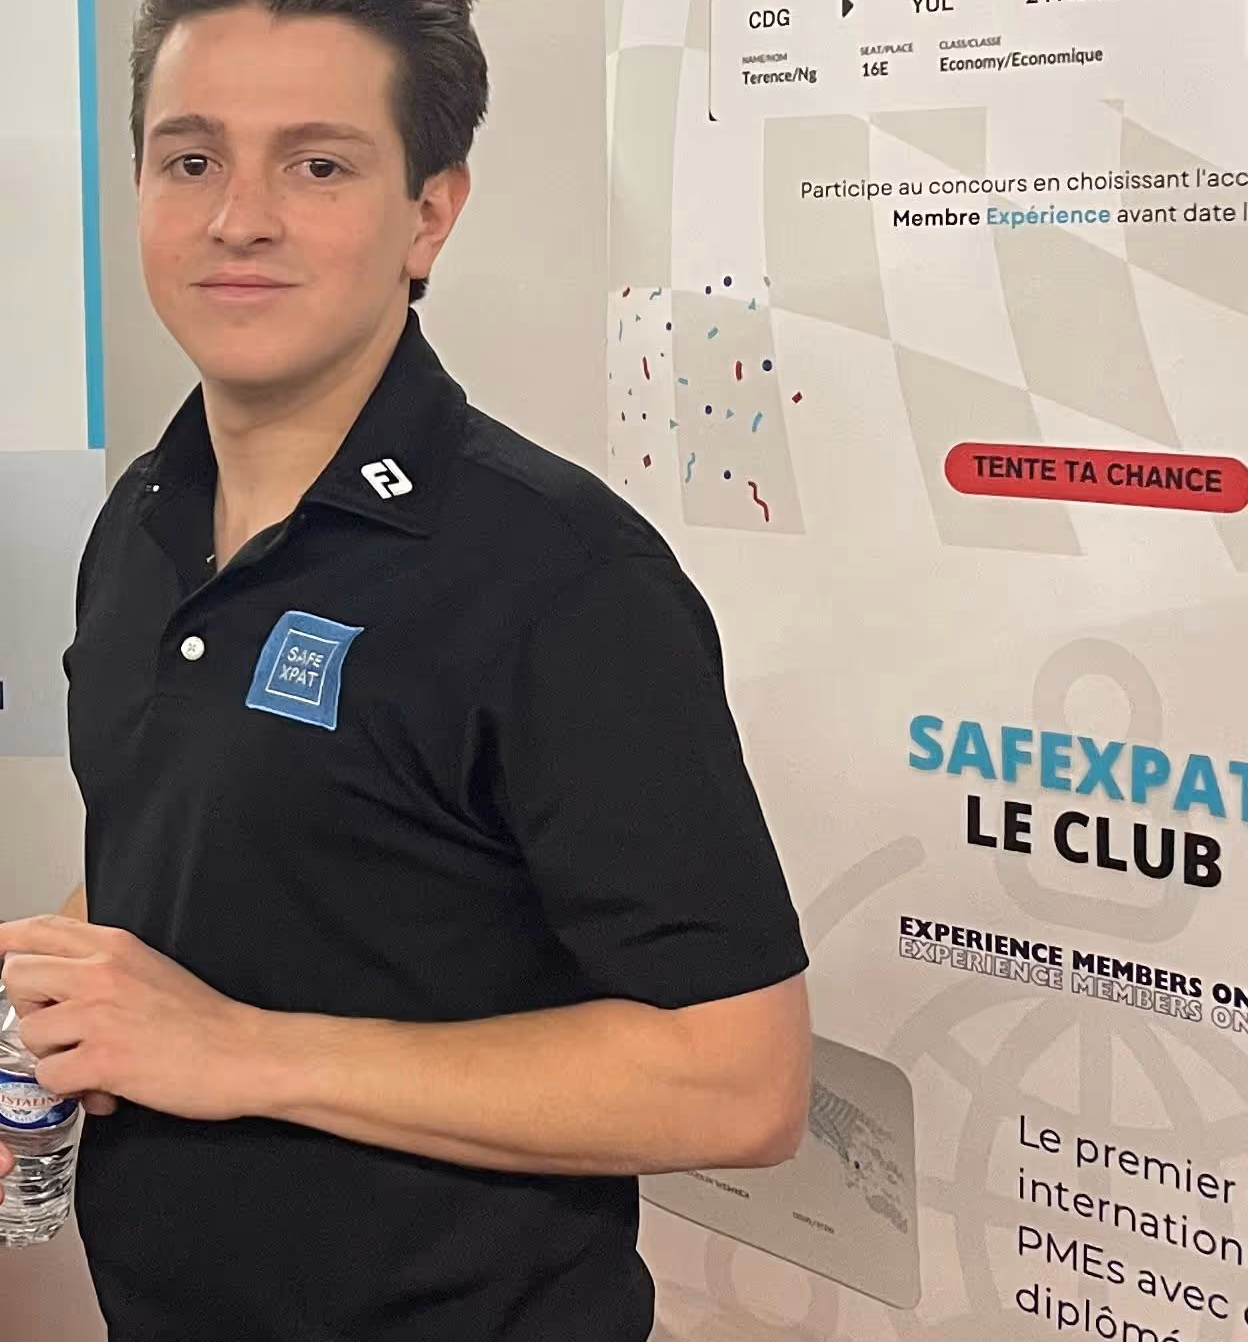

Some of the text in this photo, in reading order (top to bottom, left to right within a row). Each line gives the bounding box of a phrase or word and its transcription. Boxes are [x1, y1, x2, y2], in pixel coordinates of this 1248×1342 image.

[749, 9, 790, 28] CDG
[742, 66, 817, 85] Terence/Ng
[862, 61, 888, 77] 16E
[801, 179, 892, 200] Participe
[899, 182, 922, 195] au
[929, 177, 1027, 194] concours
[1033, 177, 1060, 192] en
[1067, 170, 1190, 191] choisissant
[893, 208, 980, 227] Membre
[987, 205, 1110, 229] Expérience
[1117, 206, 1176, 223] avant
[1183, 203, 1236, 222] date
[973, 455, 1222, 493] TENTE TA CHANCE
[287, 646, 325, 668] SAFE
[278, 665, 320, 688] XPAT
[967, 794, 1222, 888] LE CLUB
[901, 915, 1063, 967] EXPERIENCE
[1072, 949, 1202, 998] MEMBERS
[899, 936, 1063, 990] EXPERIENCE
[1071, 972, 1202, 1022] MEMBERS
[1019, 1114, 1236, 1205] Le premier
[1018, 1168, 1242, 1266] internation
[1019, 1226, 1229, 1319] PMEs avec
